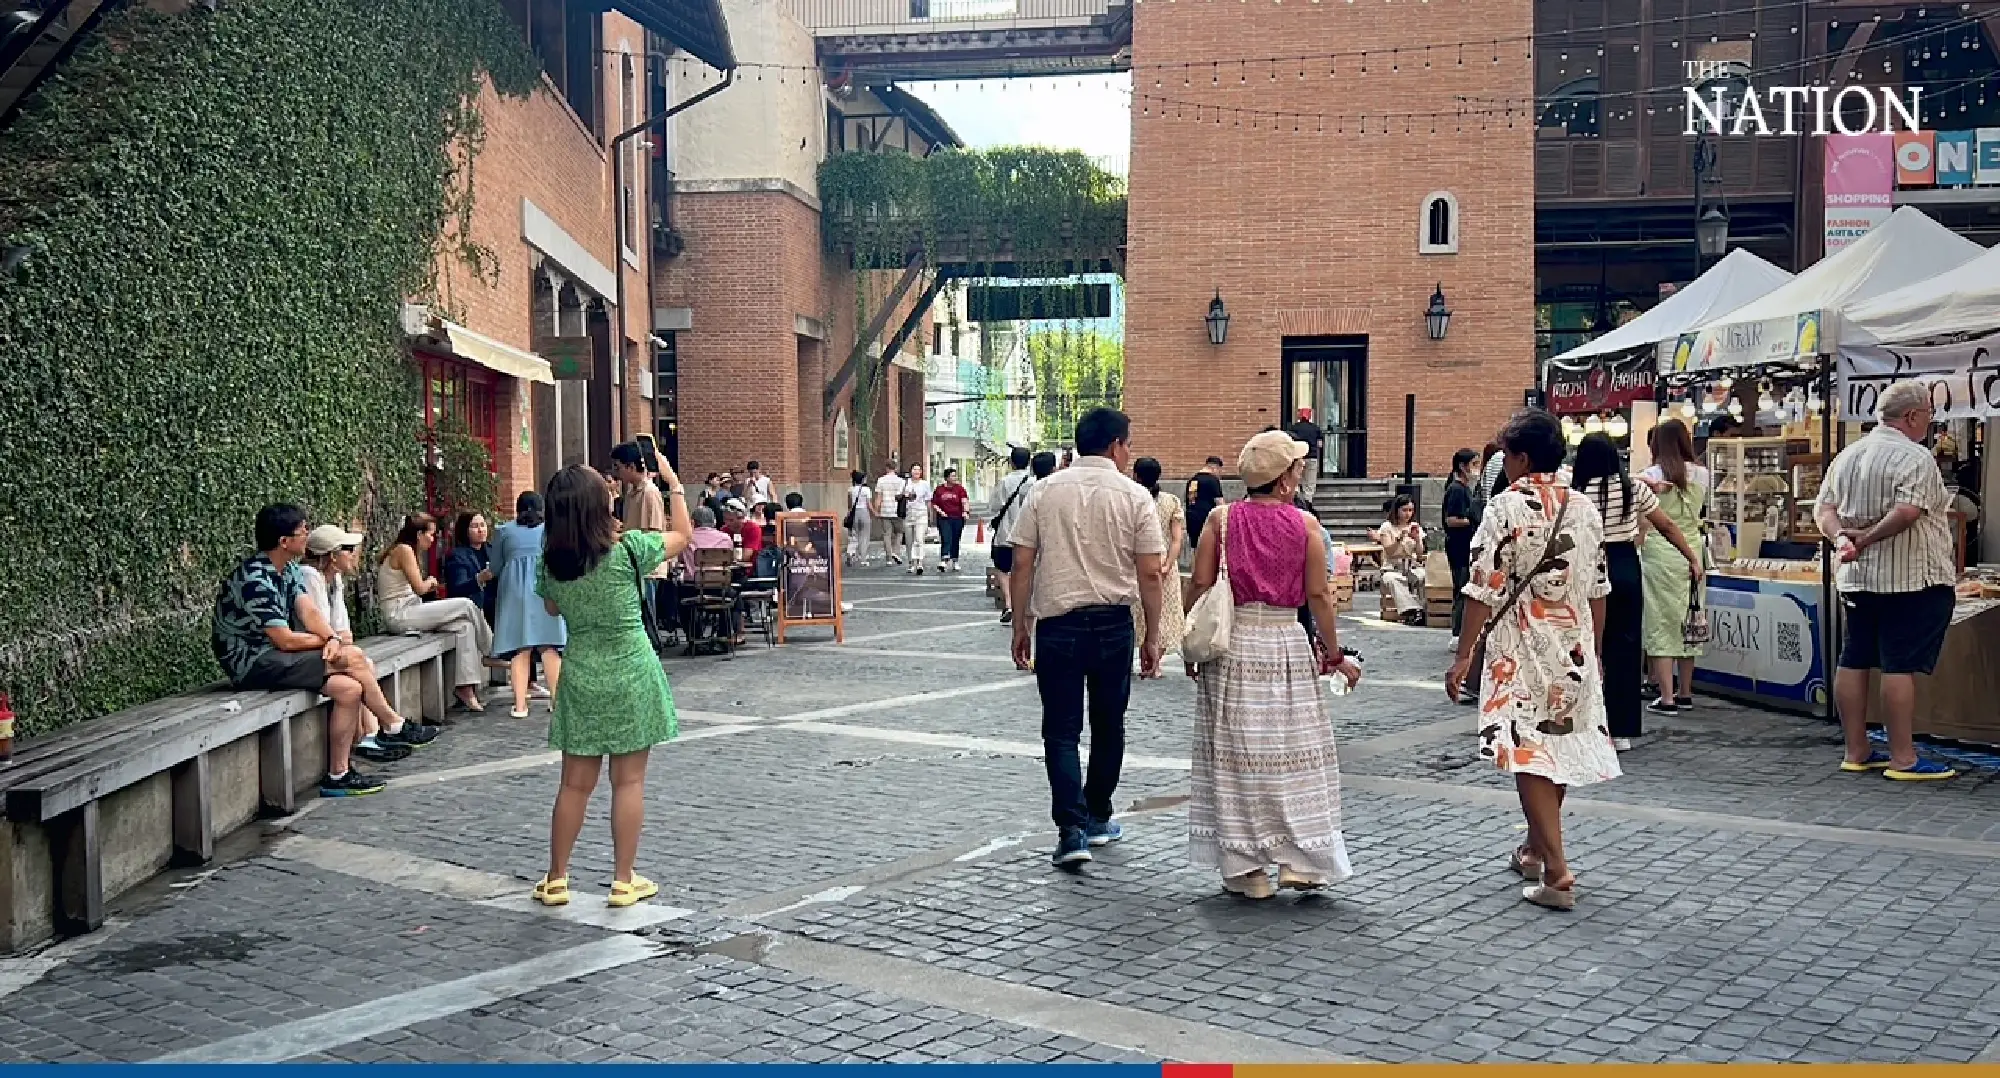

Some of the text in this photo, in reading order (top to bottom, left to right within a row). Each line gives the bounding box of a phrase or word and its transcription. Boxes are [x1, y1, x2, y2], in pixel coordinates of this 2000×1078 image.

[1826, 194, 1890, 204] SHOPPING
[1827, 219, 1870, 228] FASHION
[1715, 321, 1763, 350] SUGAR
[1705, 608, 1760, 651] UGAR
